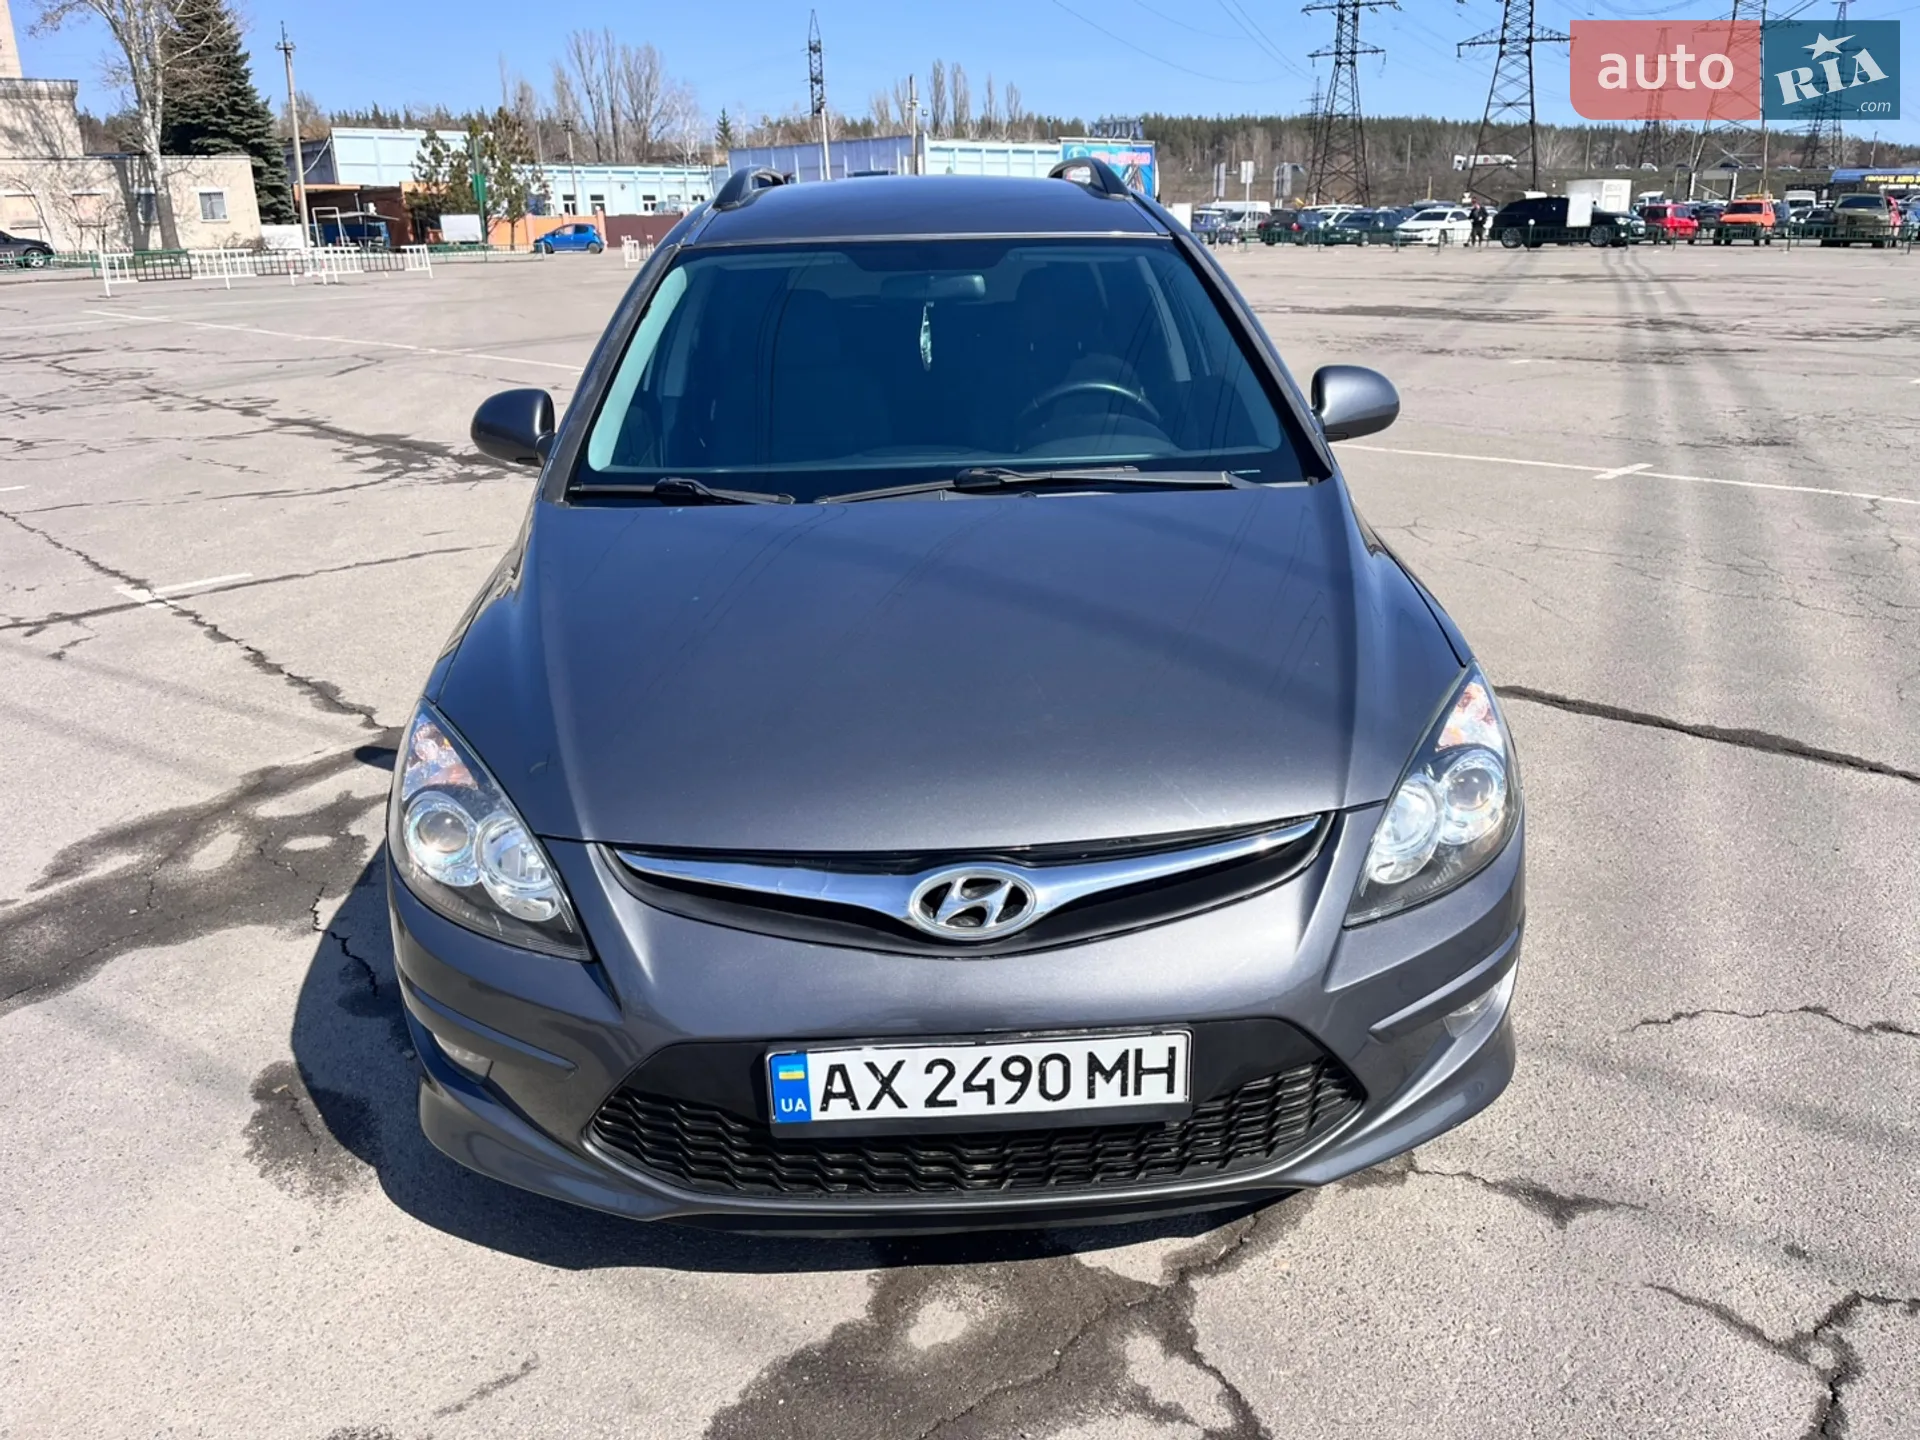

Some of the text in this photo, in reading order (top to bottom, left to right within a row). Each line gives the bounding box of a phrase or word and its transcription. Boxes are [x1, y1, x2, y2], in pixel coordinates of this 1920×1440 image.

[819, 1046, 1176, 1112] AX 2490 MH
[781, 1097, 807, 1112] UA
